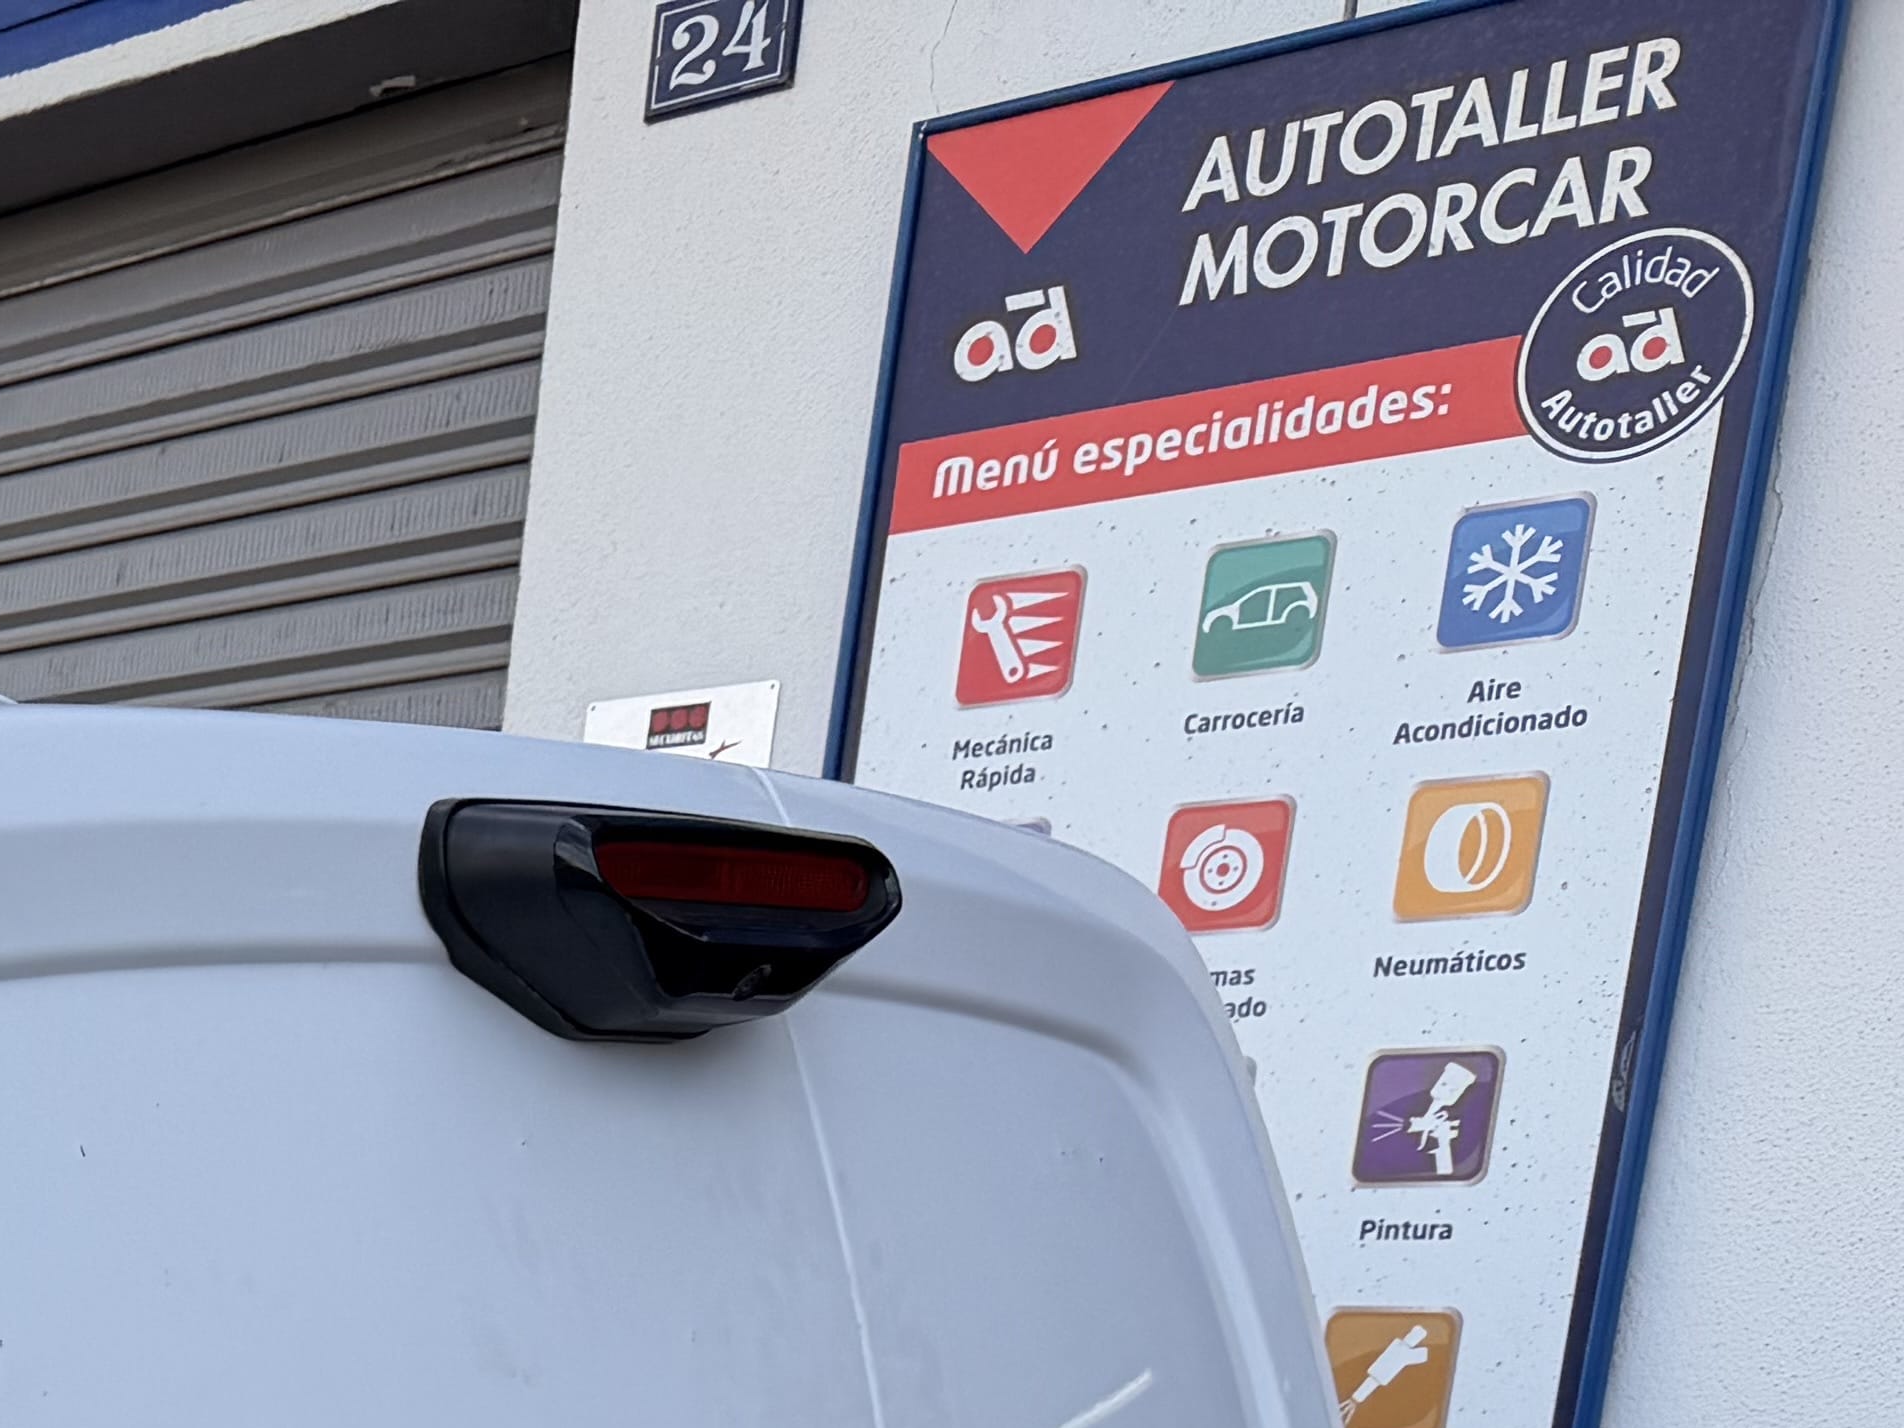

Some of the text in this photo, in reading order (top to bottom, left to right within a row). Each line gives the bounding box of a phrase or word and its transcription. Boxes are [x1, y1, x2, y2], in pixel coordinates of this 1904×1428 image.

[669, 0, 771, 91] 24
[1182, 37, 1682, 212] AUTOTALLER
[1180, 146, 1654, 306] MOTORCAR
[1572, 246, 1721, 314] Calidad
[1541, 364, 1712, 442] Autotaller
[933, 383, 1454, 498] Menú especialidades:
[1467, 678, 1522, 704] Aire
[1183, 702, 1305, 736] Carrocería
[1392, 704, 1589, 746] Acondicionado
[952, 731, 1054, 761] Mecánica
[960, 762, 1037, 792] Rápida
[1209, 968, 1256, 987] mas
[1372, 949, 1528, 978] Neumáticos
[1223, 996, 1267, 1018] ado
[1358, 1218, 1454, 1241] Pintura
